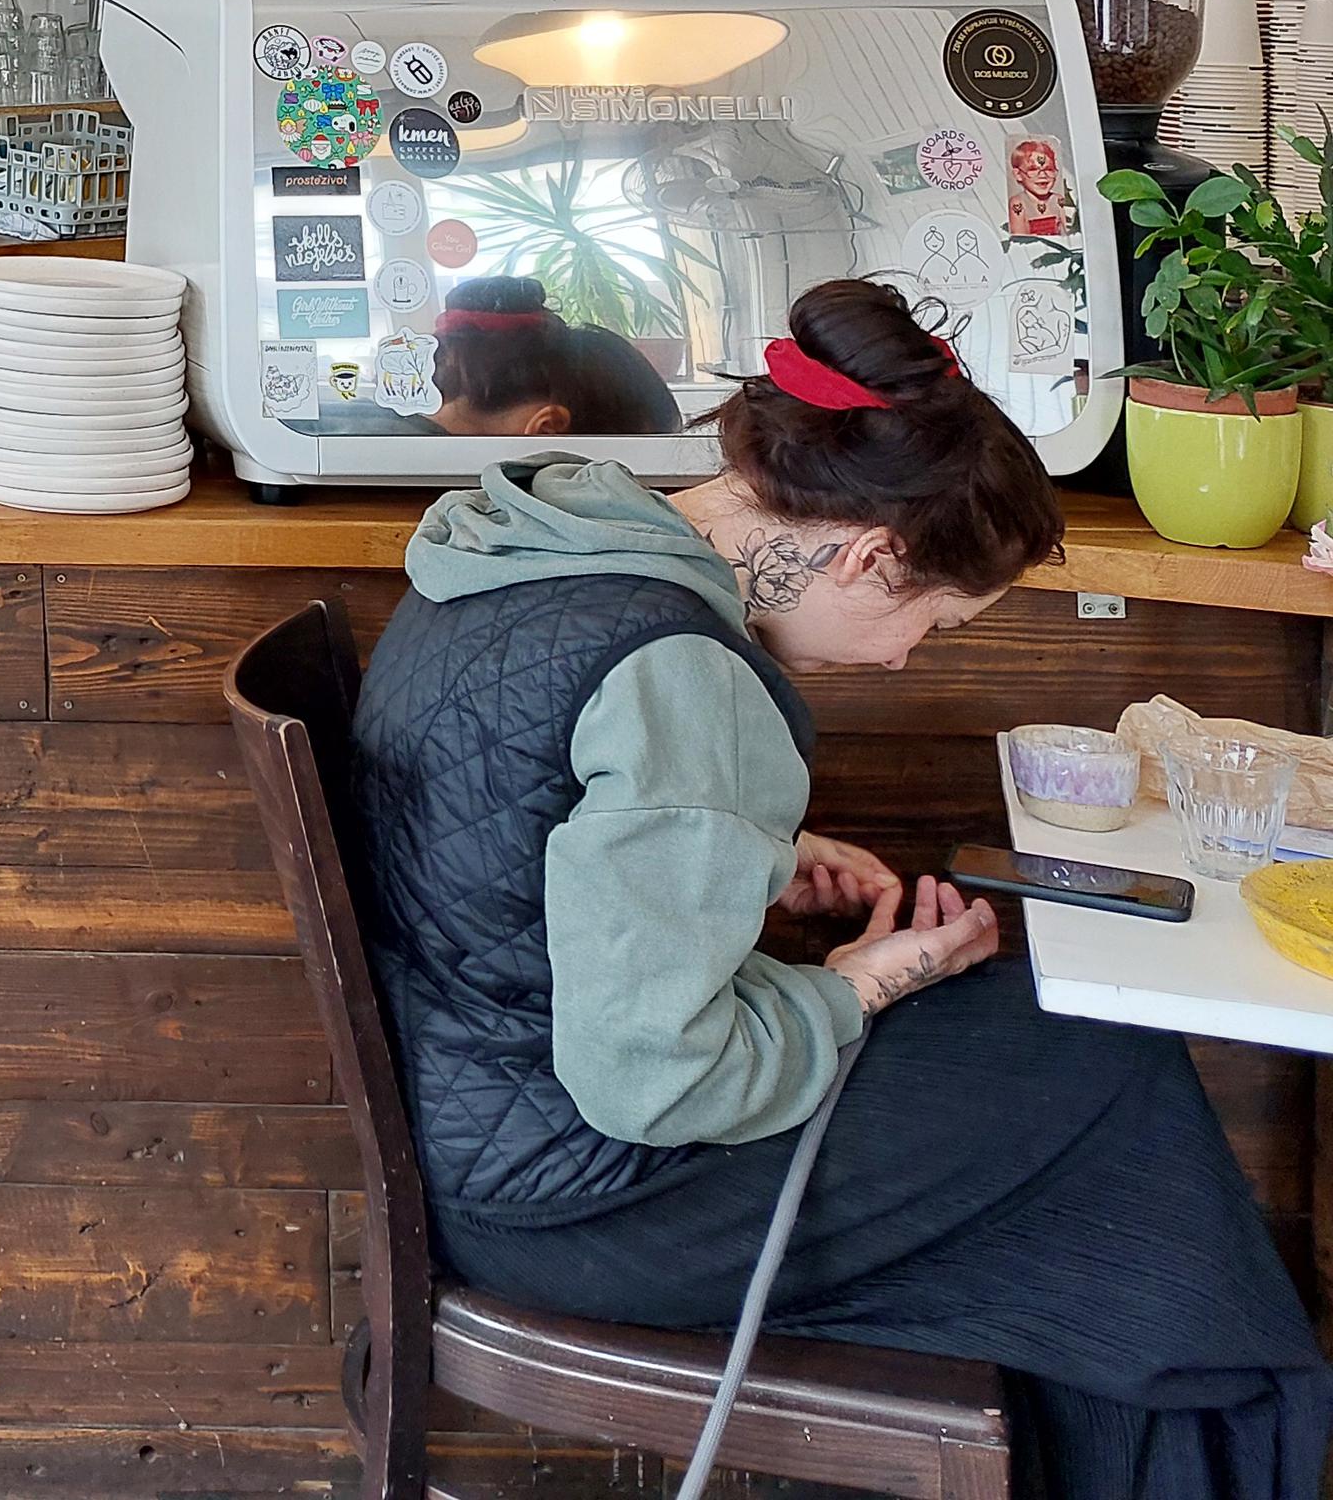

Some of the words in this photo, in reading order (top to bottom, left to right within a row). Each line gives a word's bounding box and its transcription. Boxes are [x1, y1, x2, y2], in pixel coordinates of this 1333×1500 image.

[974, 70, 991, 79] DOS
[992, 70, 1029, 79] MUNDOS
[571, 96, 793, 122] SIMONELLI
[398, 124, 450, 148] kmen
[922, 130, 965, 155] BOARDS
[969, 141, 982, 157] OF
[920, 160, 982, 191] MANGROOVE
